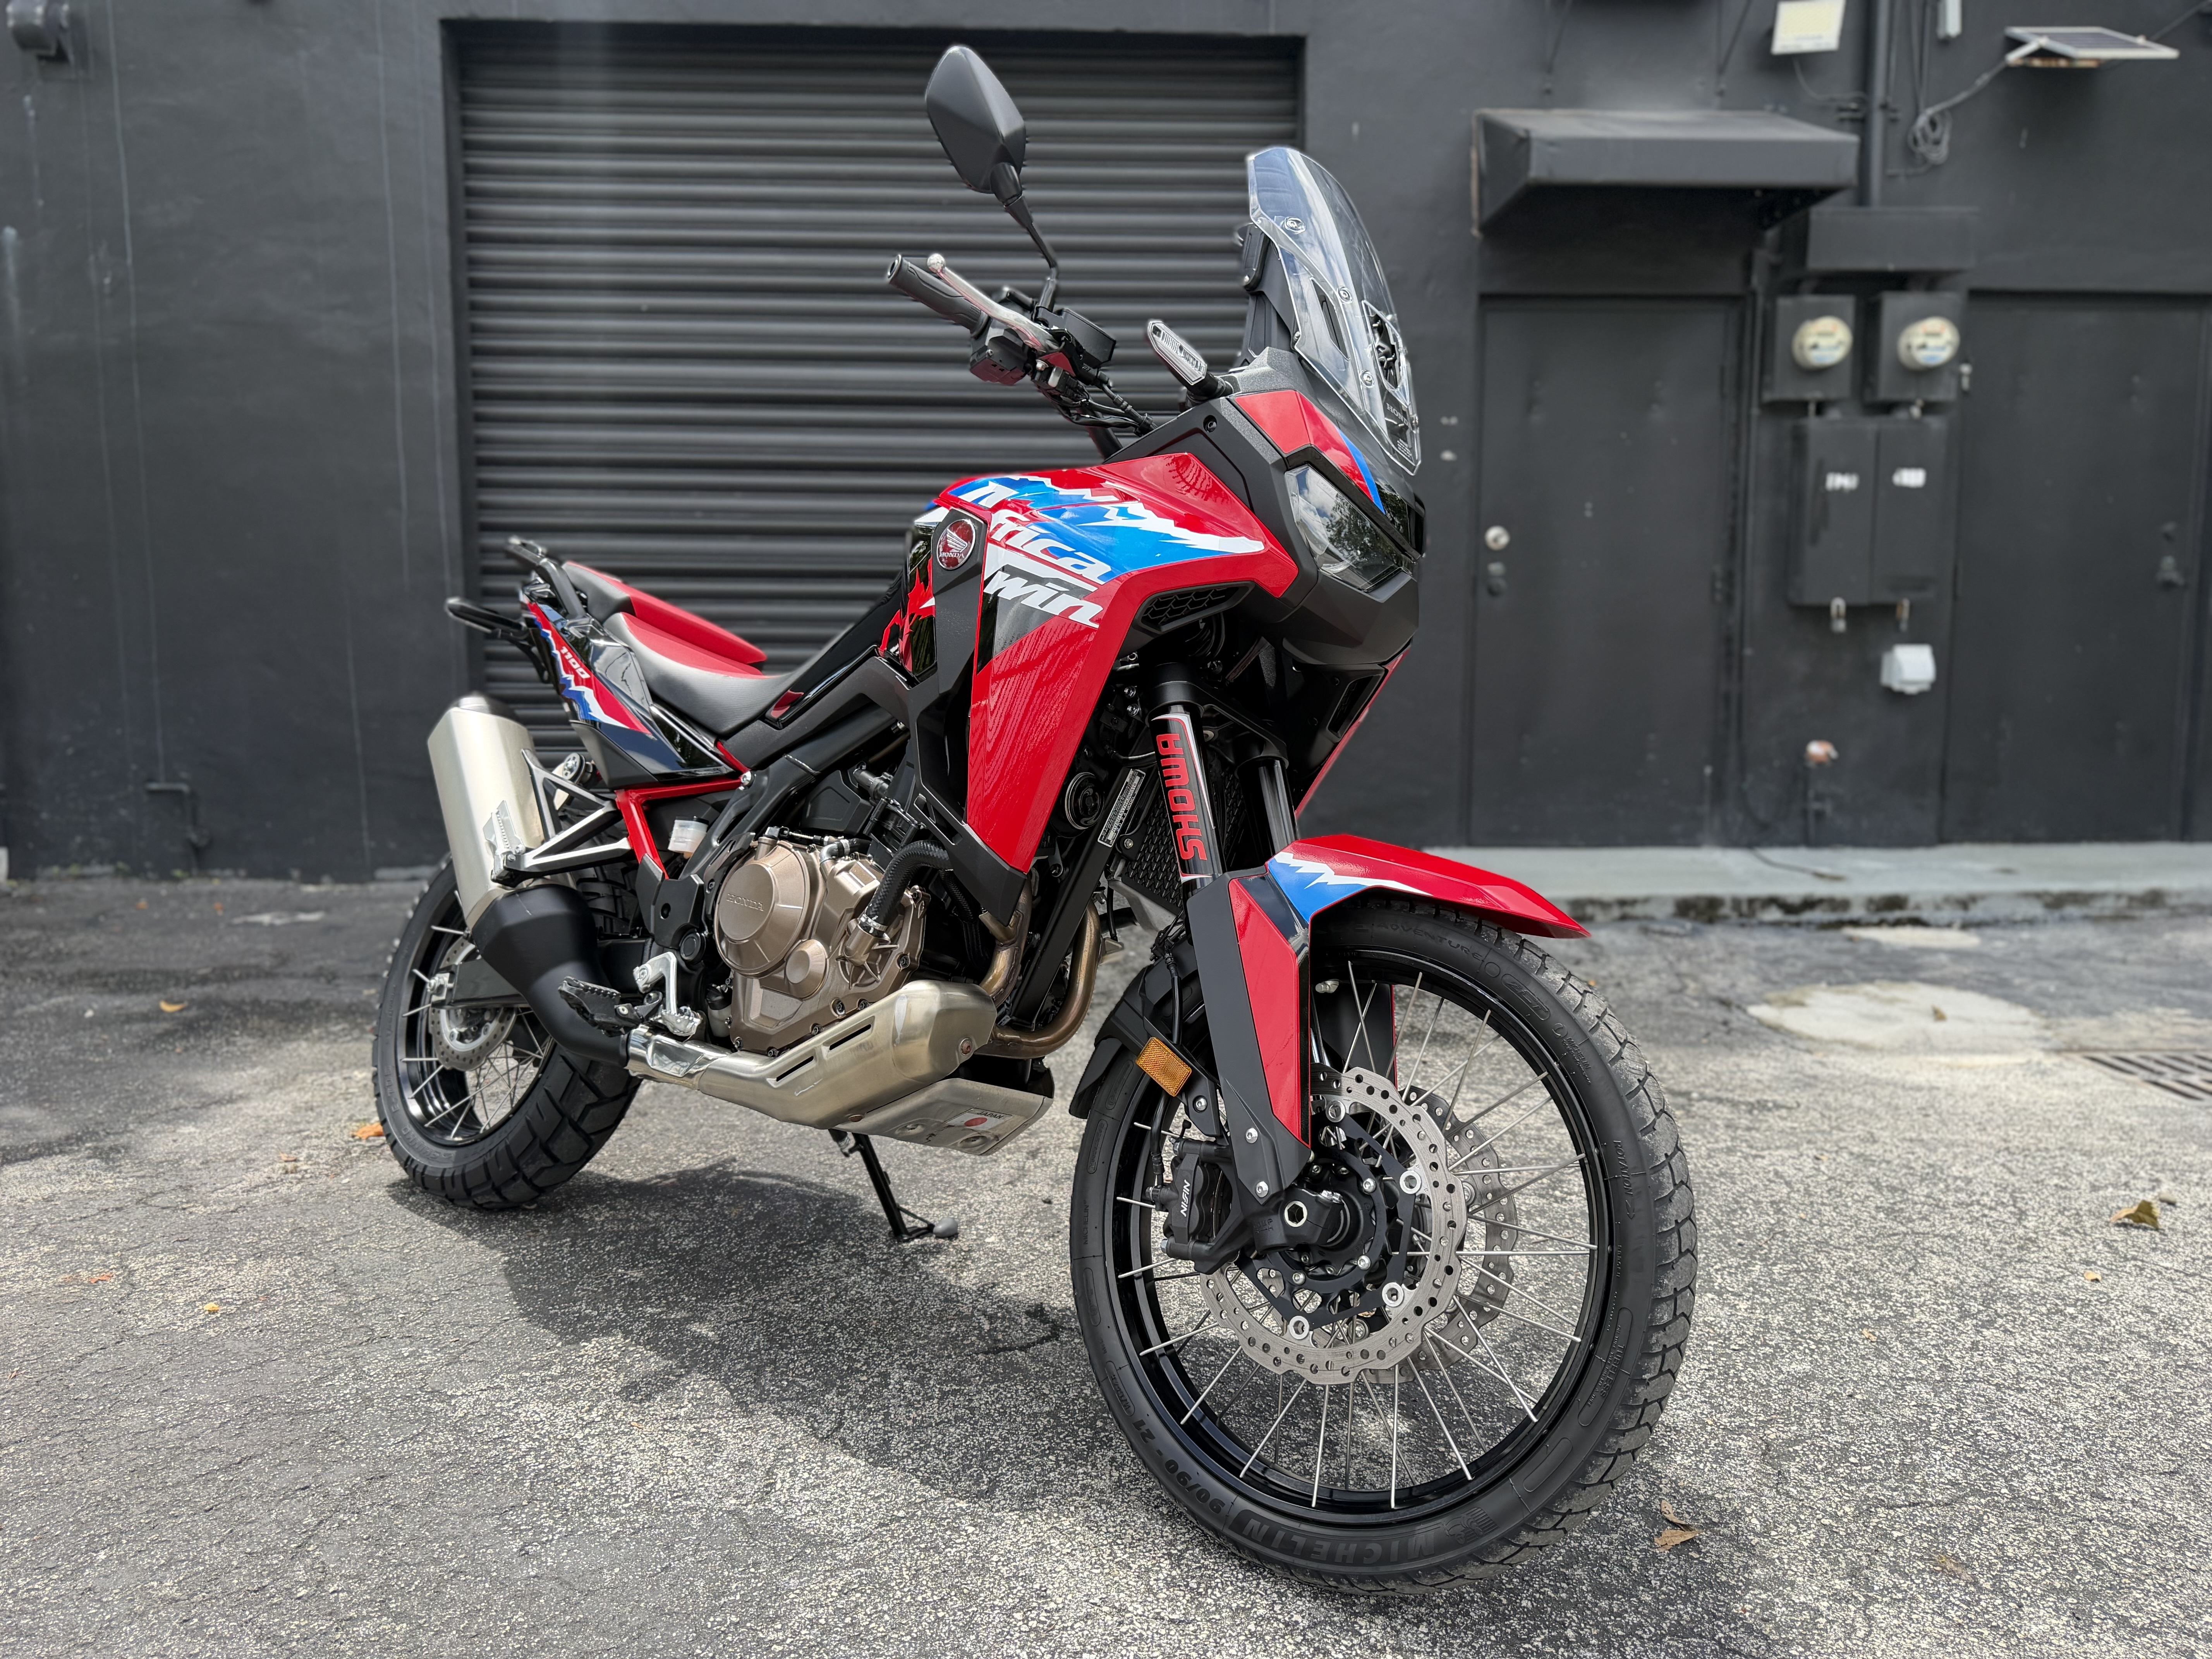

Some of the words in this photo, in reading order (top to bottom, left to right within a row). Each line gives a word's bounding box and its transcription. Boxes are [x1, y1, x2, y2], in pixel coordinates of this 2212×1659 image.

[560, 646, 591, 679] 1100
[1156, 733, 1207, 861] SHOWA
[726, 893, 764, 912] HONDA
[1377, 923, 1483, 961] ADVENTURE
[1566, 1037, 1591, 1069] MICHELIN
[977, 1111, 1004, 1120] JAPAN
[1613, 1140, 1633, 1196] ROTATION
[1180, 1179, 1190, 1217] NISSIN
[1600, 1344, 1625, 1398] TUBELESS
[1132, 1418, 1155, 1443] 21
[1164, 1459, 1225, 1513] 90/90
[1243, 1521, 1435, 1565] MICHELIN
